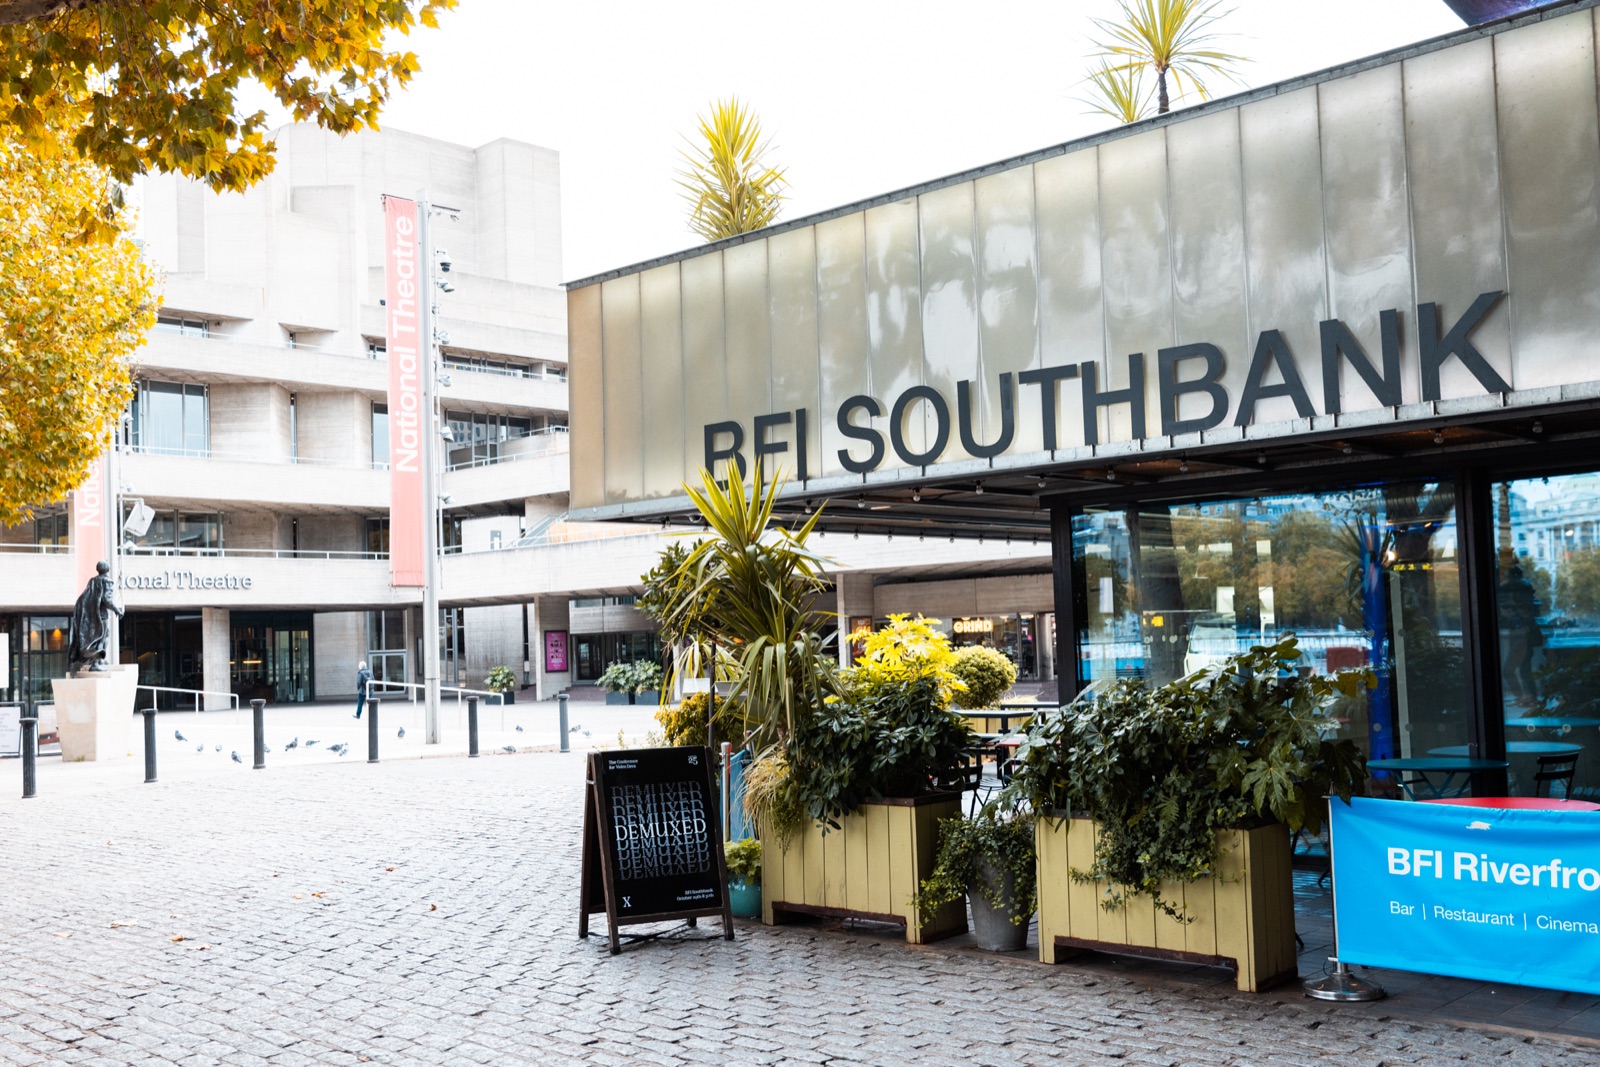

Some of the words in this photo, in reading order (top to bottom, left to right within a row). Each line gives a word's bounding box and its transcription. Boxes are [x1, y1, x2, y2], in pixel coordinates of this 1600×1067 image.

[392, 215, 415, 338] Theatre
[704, 408, 807, 491] BFI
[837, 291, 1513, 474] SOUTHBANK
[393, 347, 419, 472] National
[173, 571, 252, 590] Theatre
[953, 620, 993, 633] GRIND
[615, 818, 707, 841] DEMUXED
[1387, 847, 1443, 878] BFI
[1453, 851, 1600, 891] Riverfro
[622, 896, 632, 908] X
[1390, 901, 1415, 916] Bar
[1433, 905, 1515, 926] Restaurant
[1536, 915, 1599, 934] Cinema
